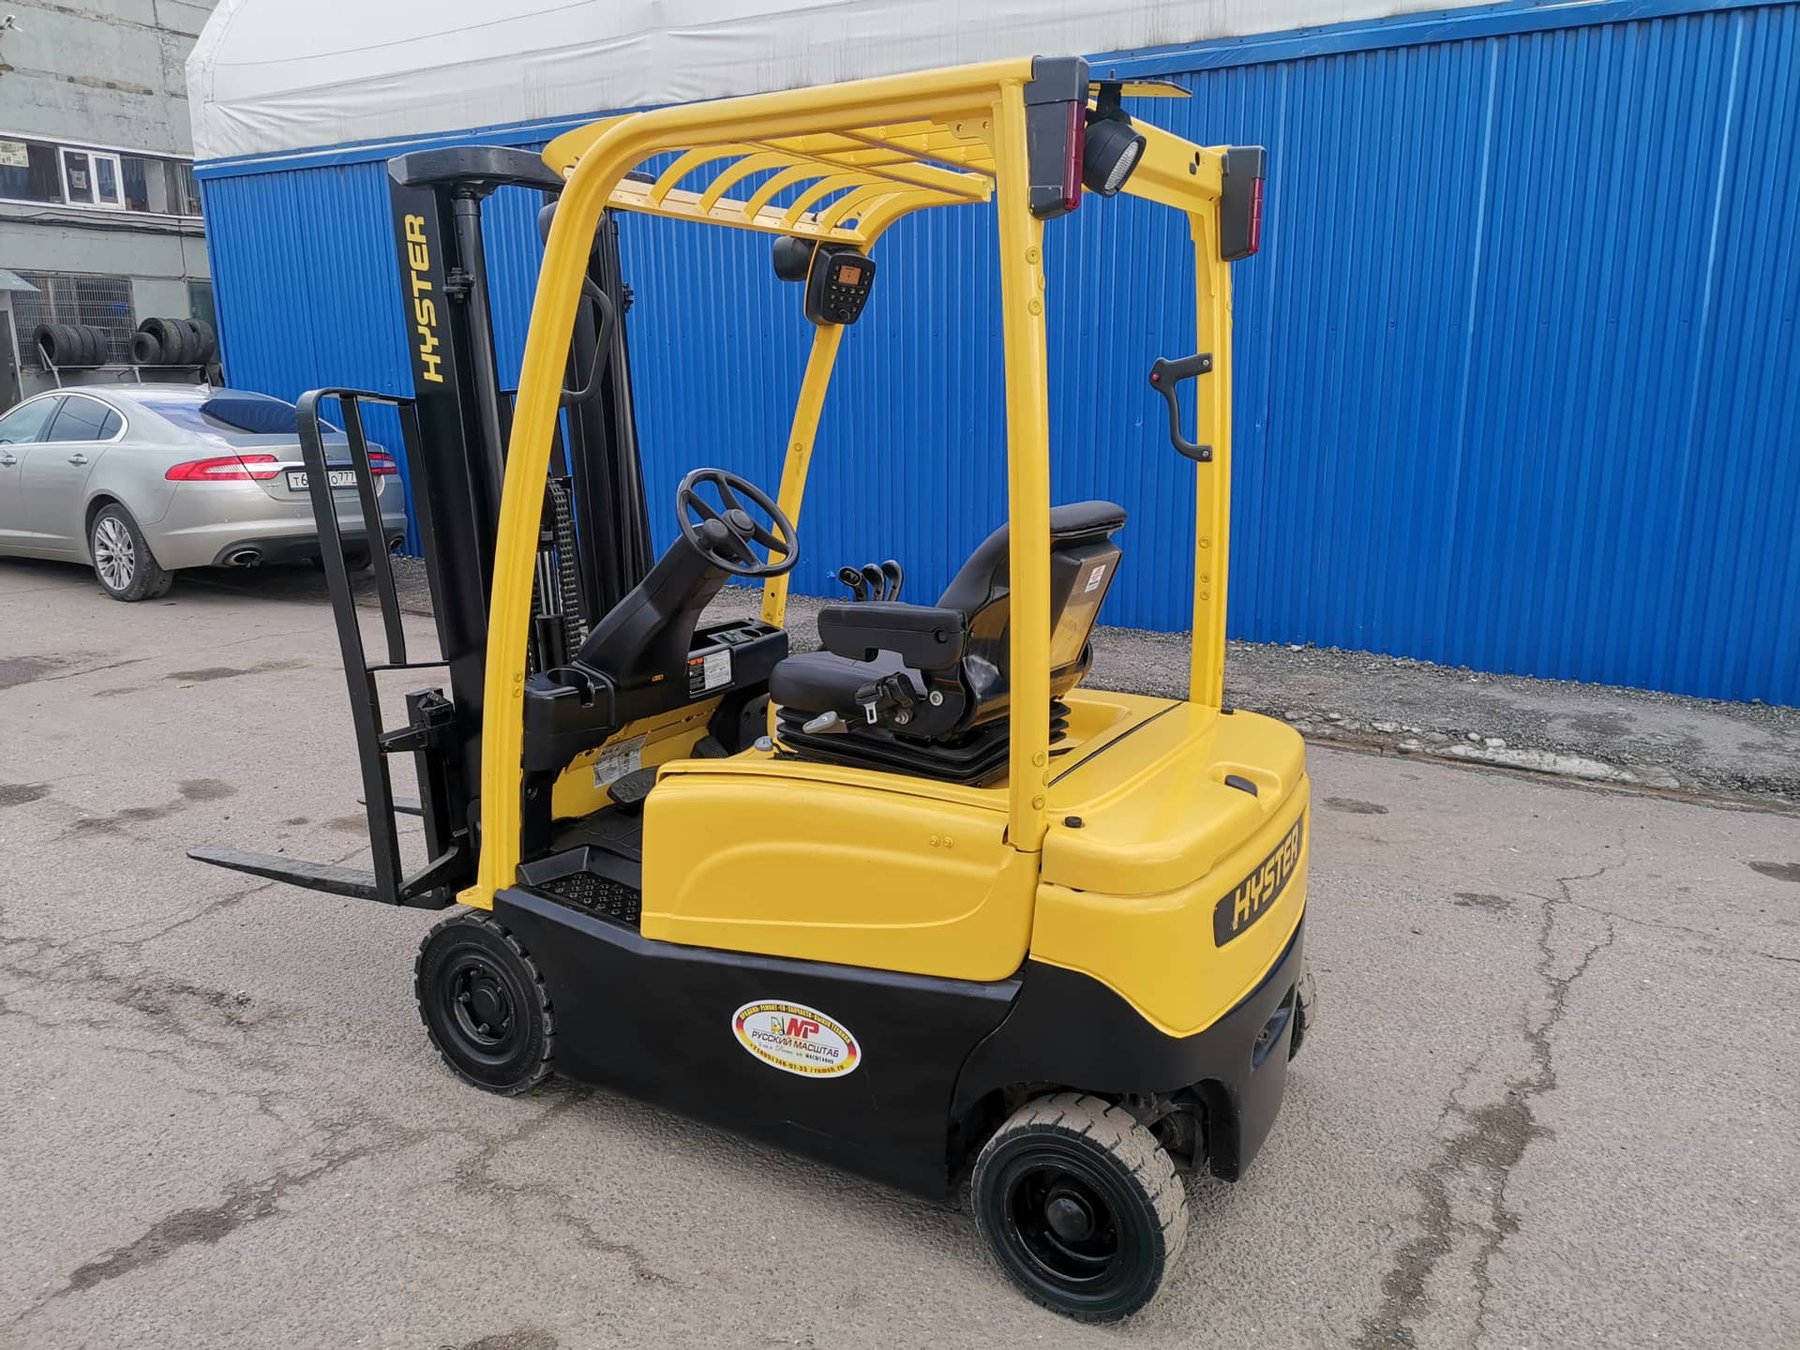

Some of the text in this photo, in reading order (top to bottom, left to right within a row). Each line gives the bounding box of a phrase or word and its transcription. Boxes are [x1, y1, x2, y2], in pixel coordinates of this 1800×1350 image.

[404, 213, 444, 383] HYSTER
[1232, 824, 1299, 931] HYSTER
[751, 1030, 792, 1047] РУССКИЙ
[793, 1040, 840, 1058] МАСШТАБ
